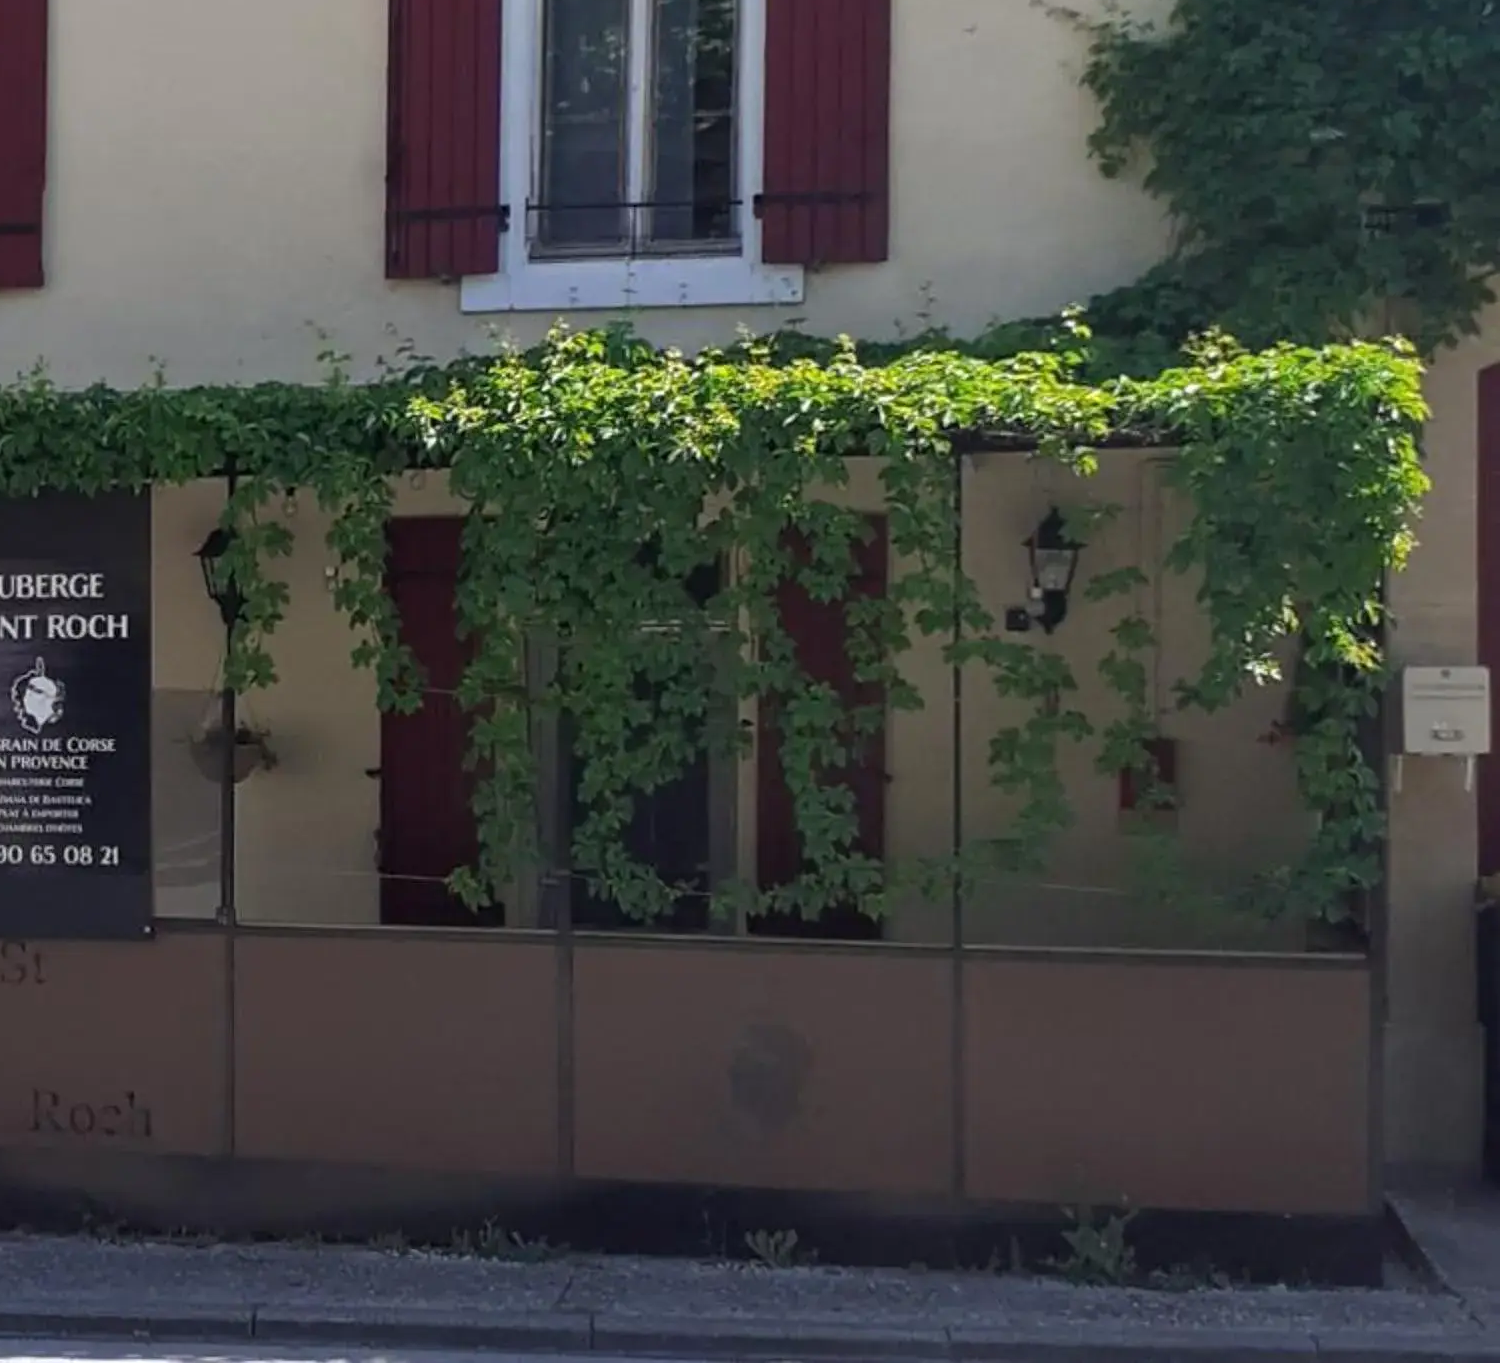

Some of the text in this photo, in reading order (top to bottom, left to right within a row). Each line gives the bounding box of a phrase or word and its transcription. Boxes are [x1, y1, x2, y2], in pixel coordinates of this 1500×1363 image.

[48, 614, 129, 640] ROCH
[43, 737, 62, 752] DE
[67, 736, 116, 752] CORSE
[11, 755, 89, 769] PROVENCE
[30, 844, 56, 866] 65
[64, 844, 93, 866] 08
[100, 845, 119, 865] 21
